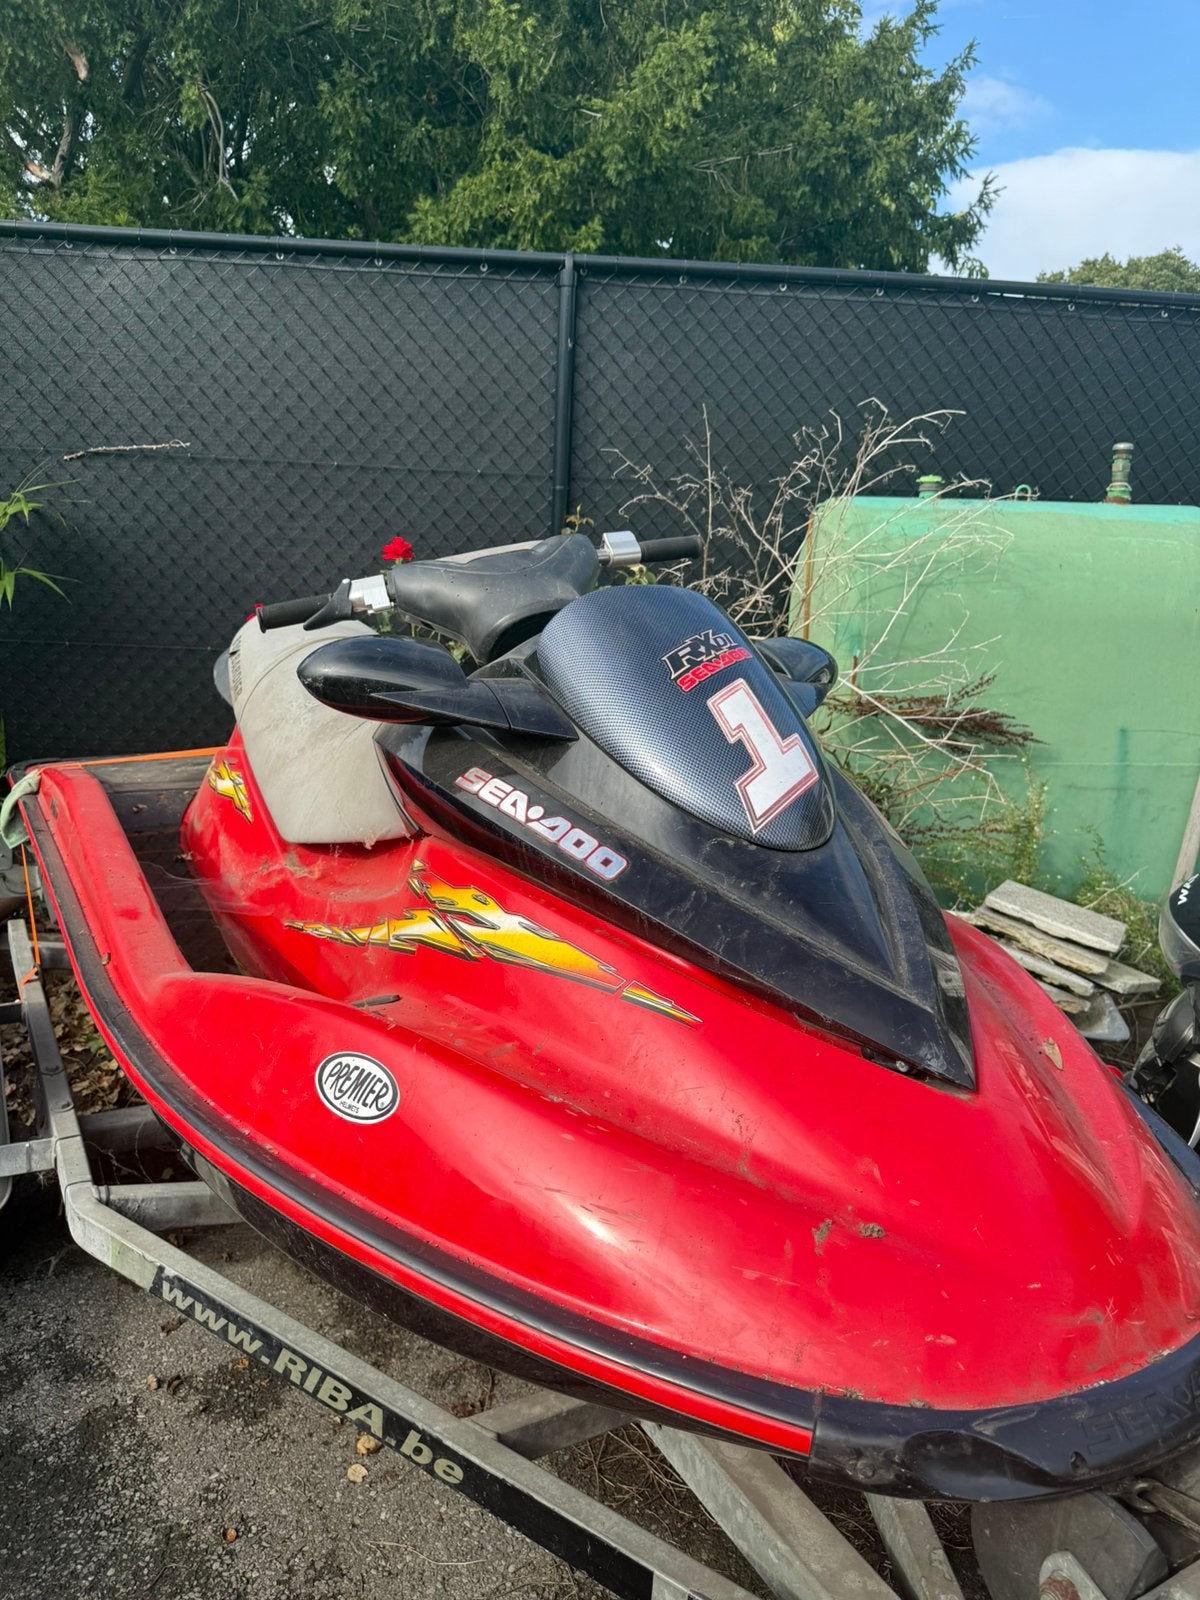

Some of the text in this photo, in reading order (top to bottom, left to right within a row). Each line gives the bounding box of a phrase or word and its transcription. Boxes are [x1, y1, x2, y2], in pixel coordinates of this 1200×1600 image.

[706, 678, 820, 835] 1
[323, 1060, 393, 1112] PREMIER
[161, 1279, 465, 1485] www.RIBA.be
